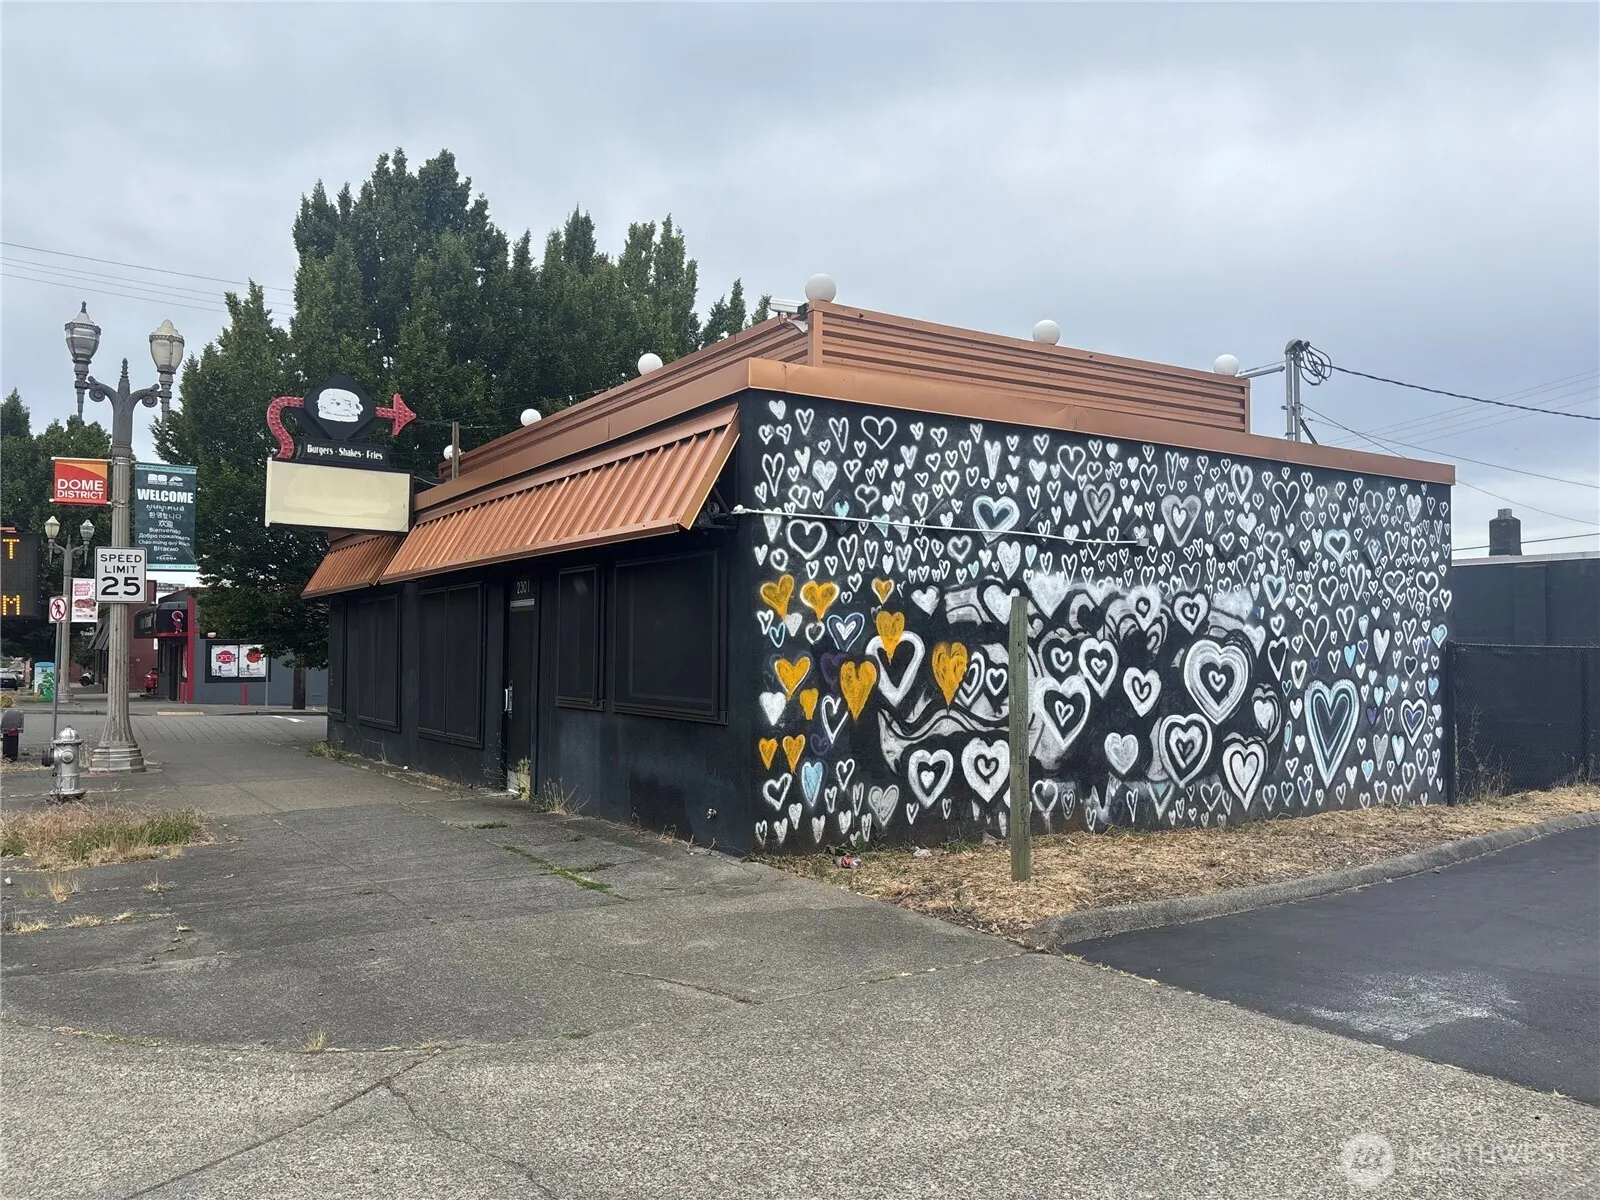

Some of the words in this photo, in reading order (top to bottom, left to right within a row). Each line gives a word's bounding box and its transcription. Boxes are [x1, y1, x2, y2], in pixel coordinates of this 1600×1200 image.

[307, 444, 334, 456] Burgers
[338, 447, 362, 458] Shakes
[366, 450, 383, 460] Fries
[57, 478, 104, 491] DOME
[57, 489, 104, 499] DISTRICT
[136, 488, 194, 504] WELCOME
[100, 554, 142, 563] SPEED
[104, 565, 137, 574] LIMIT
[100, 576, 141, 596] 25
